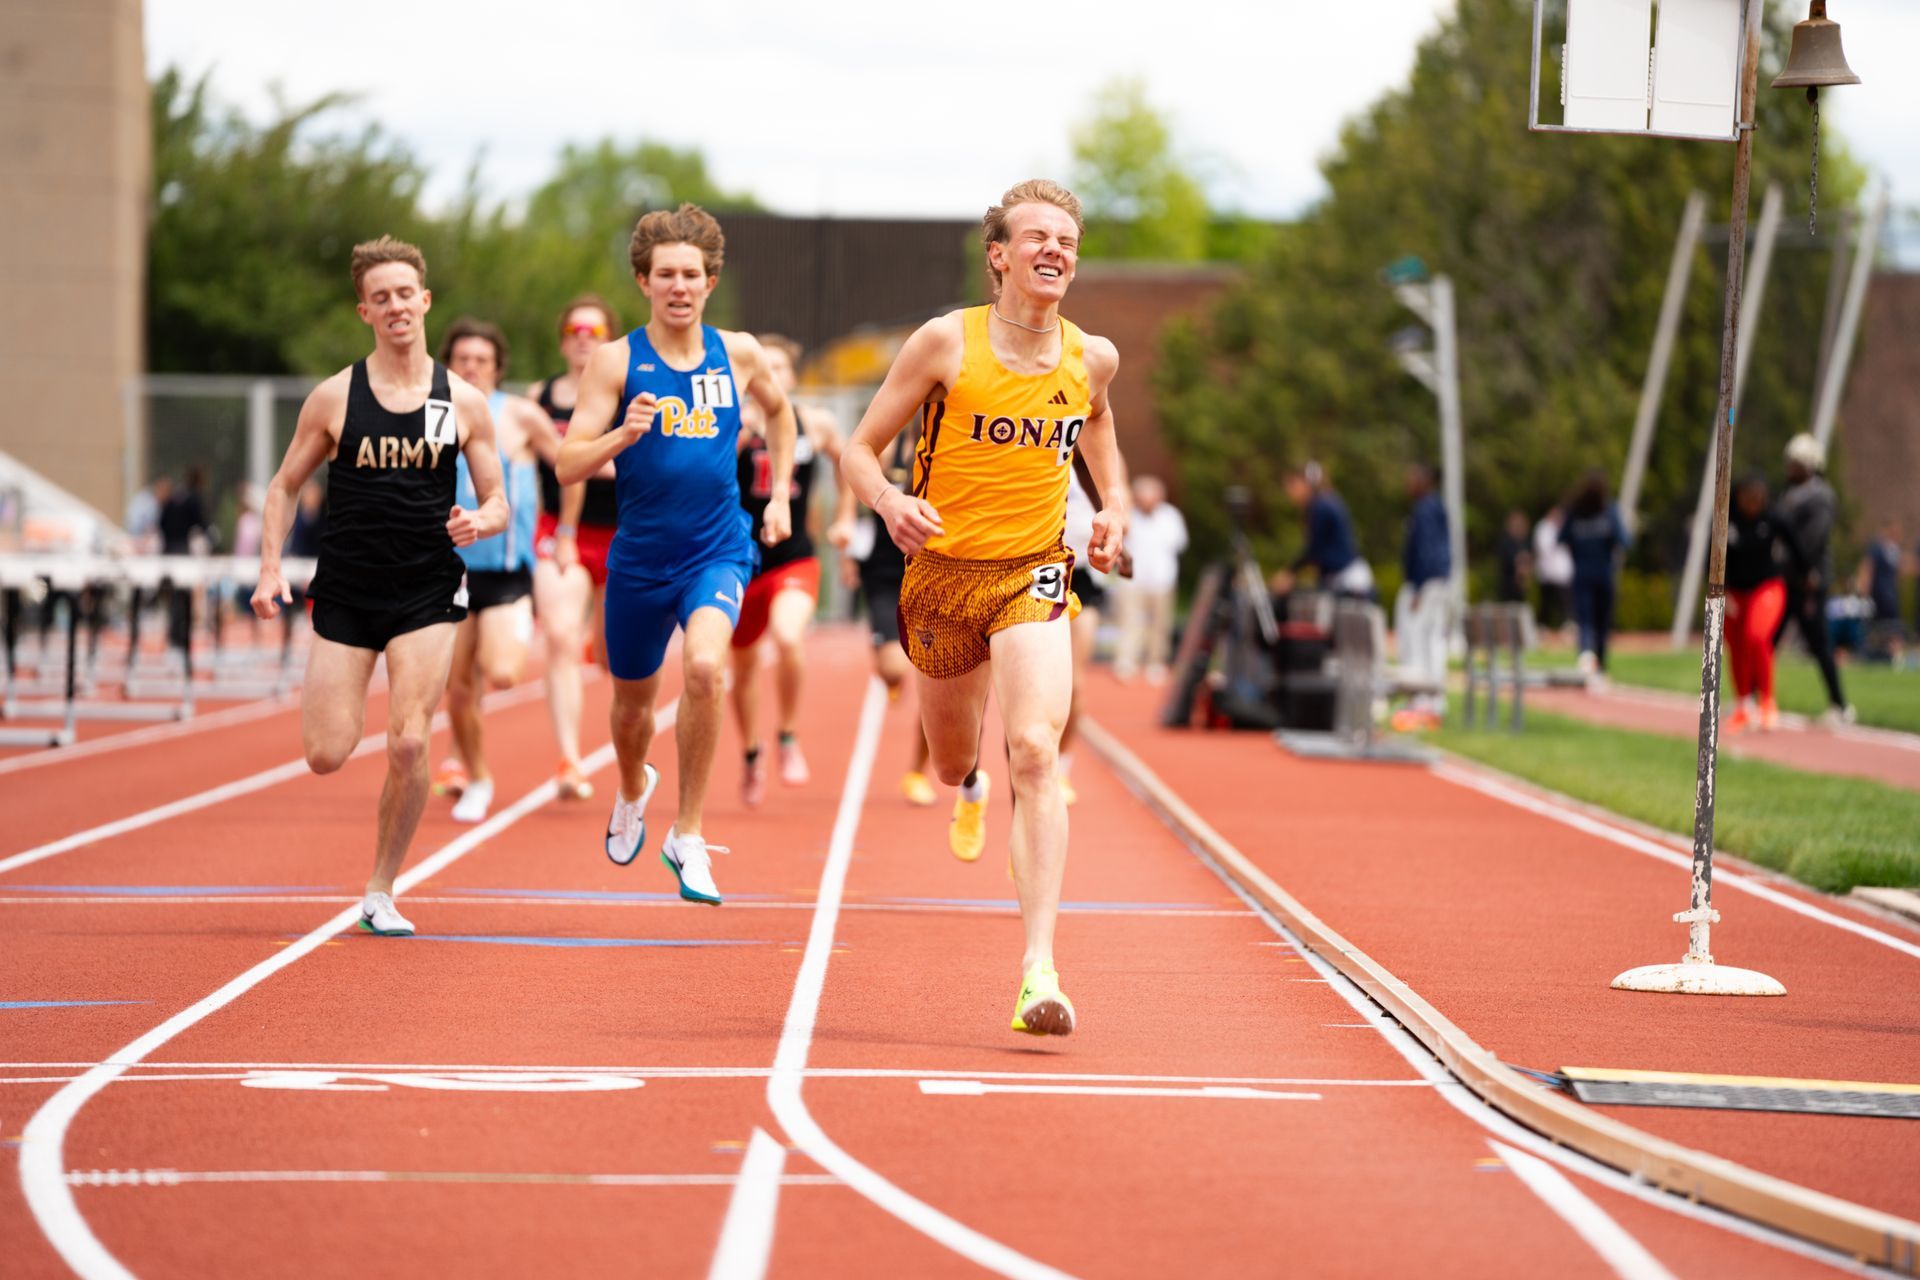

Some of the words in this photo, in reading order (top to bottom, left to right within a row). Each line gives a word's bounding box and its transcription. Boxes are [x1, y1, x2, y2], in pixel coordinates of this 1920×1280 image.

[696, 378, 723, 405] 11
[429, 404, 449, 438] 7
[655, 395, 720, 439] Pitt
[970, 413, 1064, 449] IONA
[355, 436, 445, 469] ARMY
[1062, 418, 1084, 461] 9
